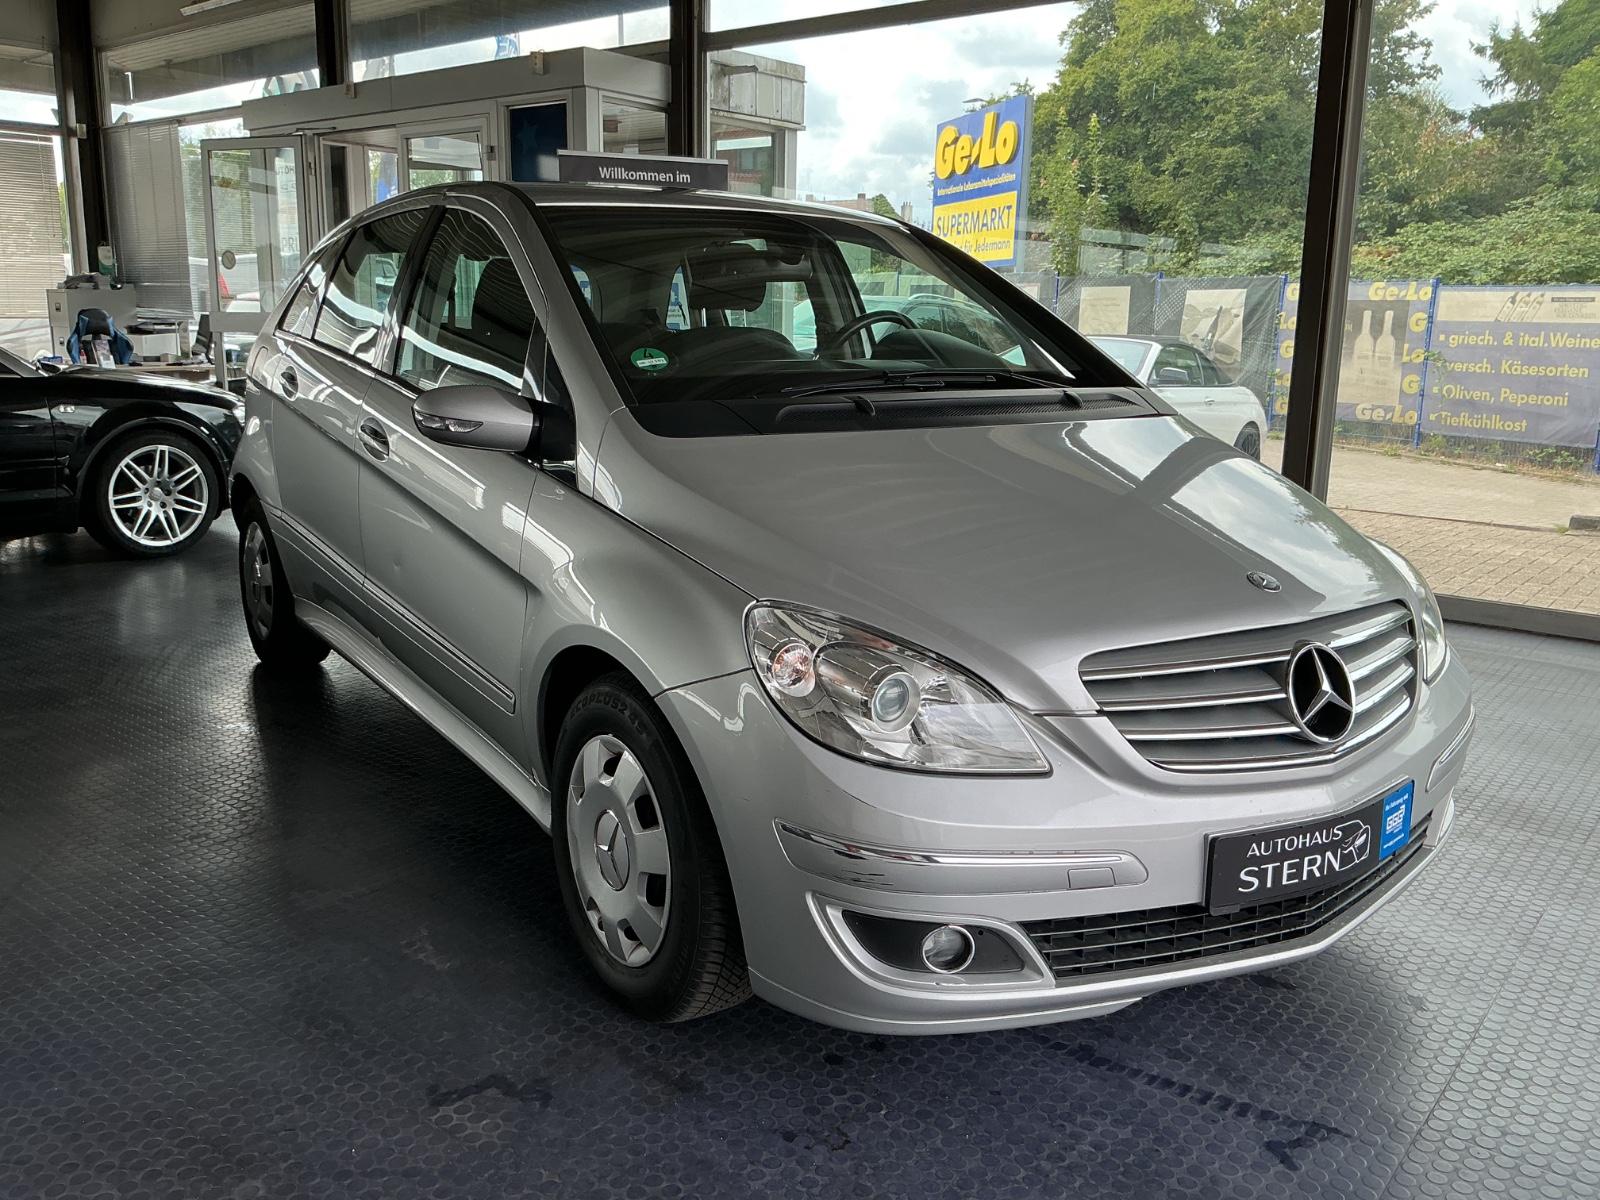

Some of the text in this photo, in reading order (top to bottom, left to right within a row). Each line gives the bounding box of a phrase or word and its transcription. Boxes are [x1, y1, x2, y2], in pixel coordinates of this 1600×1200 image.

[598, 166, 691, 183] Willkommen im
[937, 205, 1013, 238] SUPERMARKT
[974, 237, 1011, 253] Jedermann
[1448, 331, 1498, 348] griech.
[1502, 332, 1514, 346] &
[1446, 359, 1589, 379] versch. Käsesorten
[1442, 384, 1569, 408] Oliven, Peperoni
[1440, 411, 1528, 432] Tiefkühlkost
[1246, 826, 1343, 858] AUTOHAUS
[1237, 848, 1342, 892] STERN
